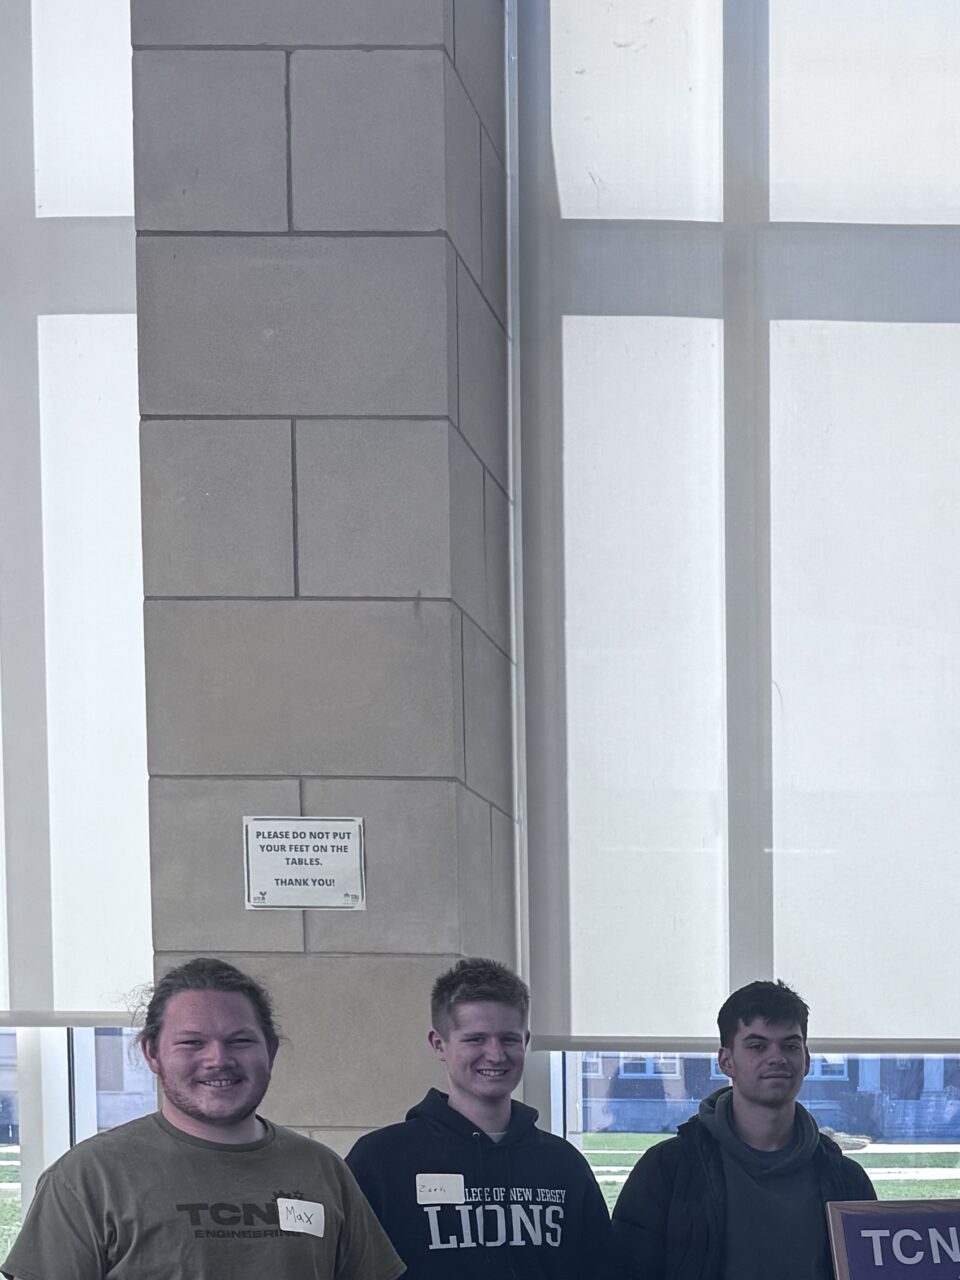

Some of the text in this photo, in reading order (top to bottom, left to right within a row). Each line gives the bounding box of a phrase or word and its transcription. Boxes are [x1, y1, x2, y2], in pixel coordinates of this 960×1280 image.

[256, 831, 352, 840] PLEASE DO NOT PUT
[259, 844, 349, 853] YOUR FEET ON THE
[284, 857, 323, 866] TABLES.
[274, 878, 335, 887] THANK YOU!
[493, 1187, 506, 1201] OF
[509, 1188, 532, 1202] NEW
[536, 1188, 566, 1204] JERSEY
[176, 1202, 280, 1226] TCN
[285, 1205, 314, 1225] Max
[423, 1204, 564, 1250] LIONS
